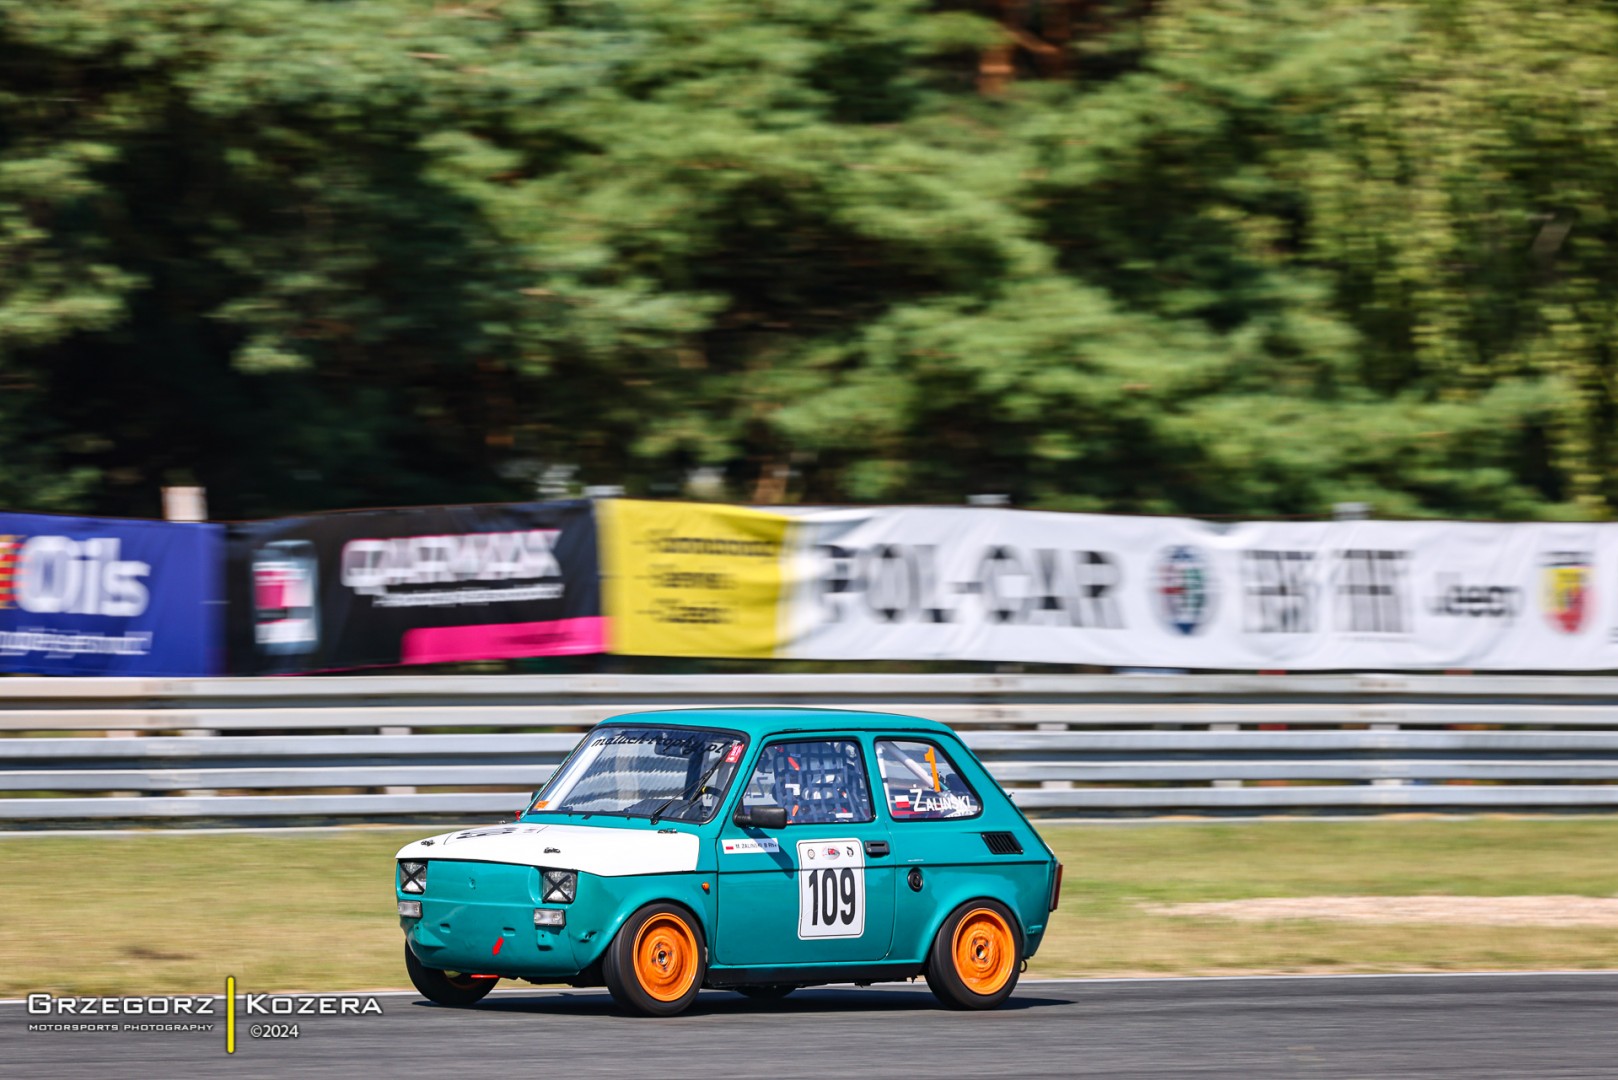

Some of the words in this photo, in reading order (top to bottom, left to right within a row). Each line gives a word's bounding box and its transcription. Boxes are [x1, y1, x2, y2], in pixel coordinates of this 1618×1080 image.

[15, 535, 151, 617] Oils
[818, 543, 1127, 629] POL-CAR
[924, 746, 941, 792] 1
[808, 867, 856, 926] 109
